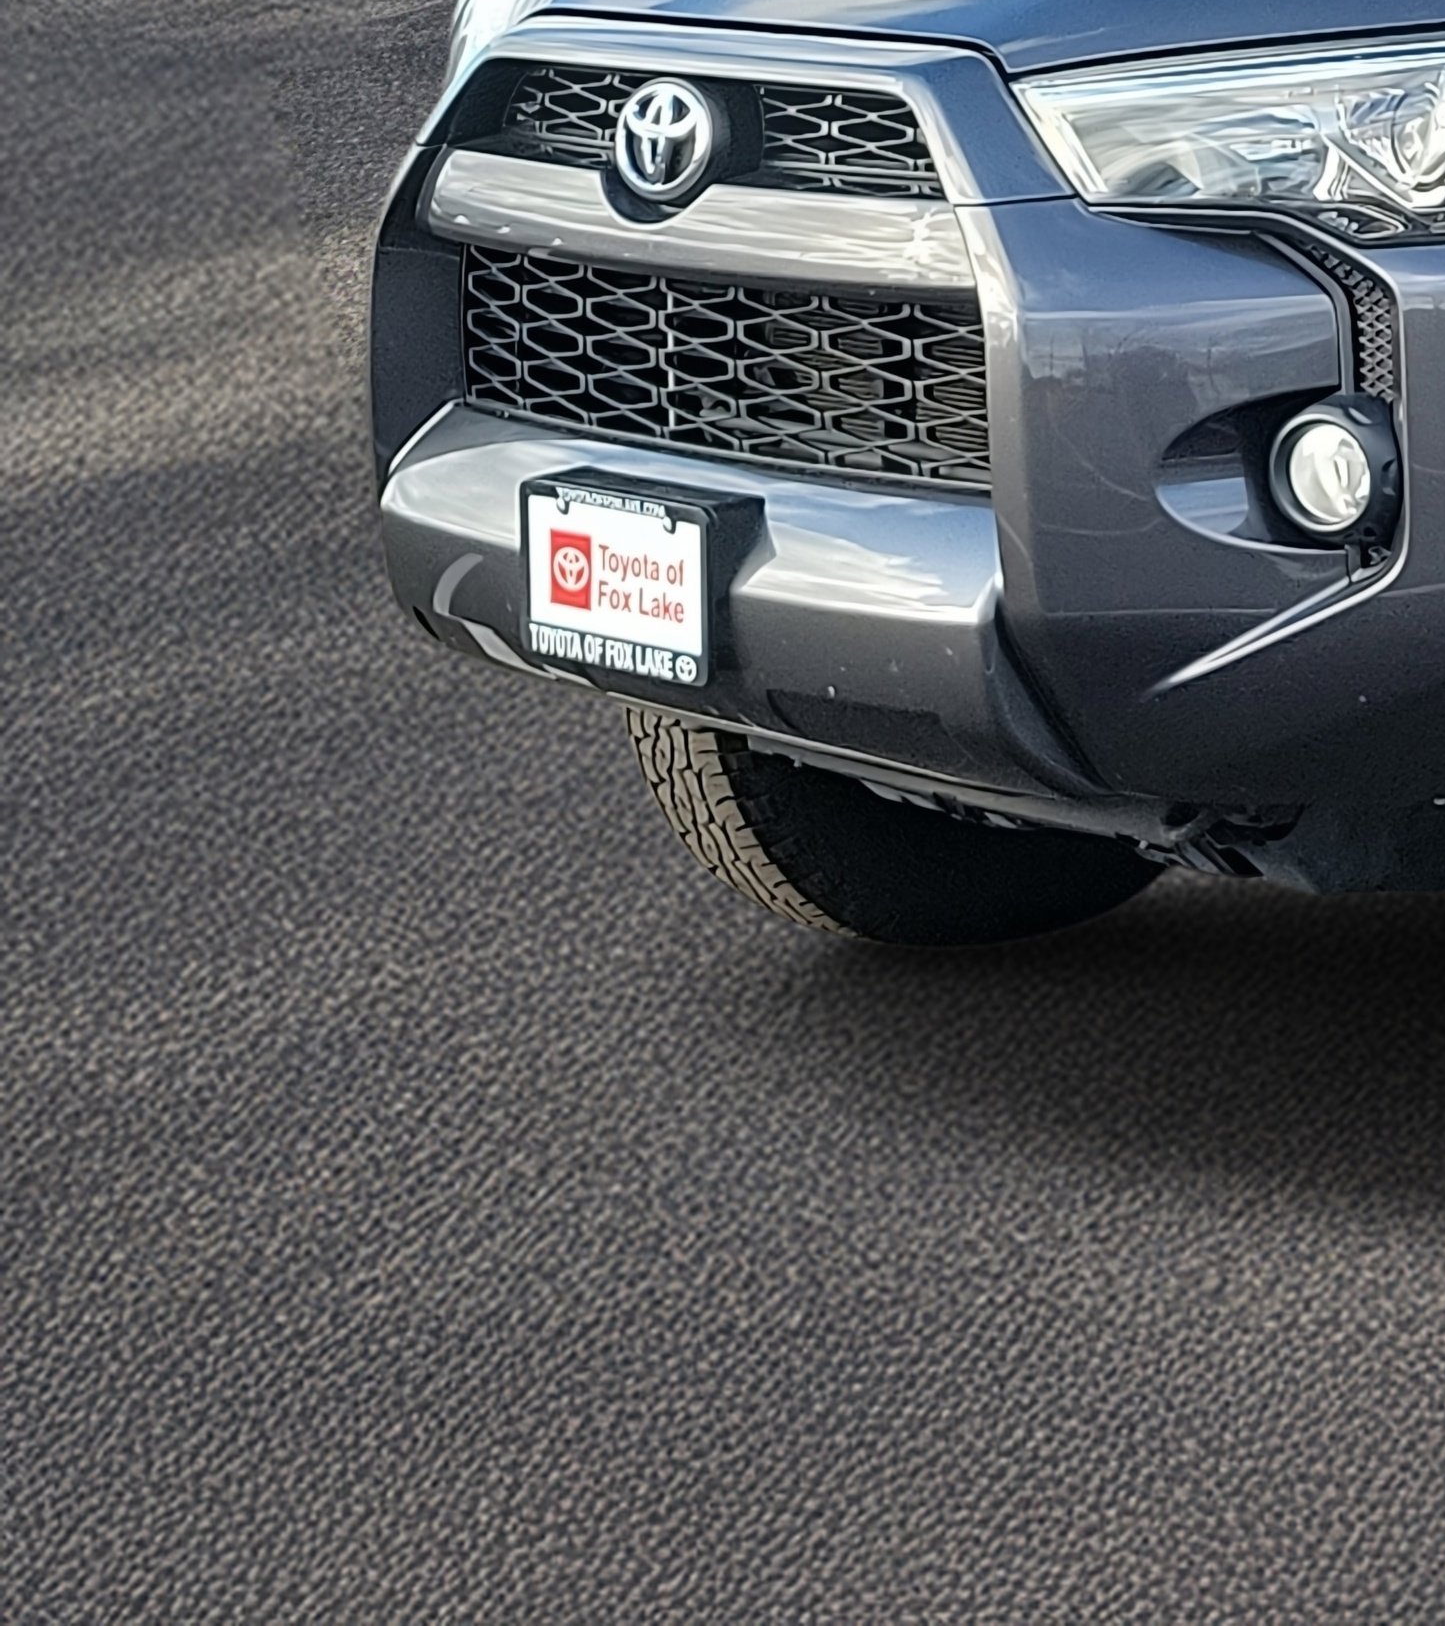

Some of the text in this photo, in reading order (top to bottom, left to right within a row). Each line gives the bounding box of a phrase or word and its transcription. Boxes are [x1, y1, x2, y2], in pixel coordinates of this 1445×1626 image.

[599, 544, 685, 587] Toyota of
[598, 580, 685, 624] Fox Lake
[529, 623, 674, 680] TOYOTA OF FOX LAKE
